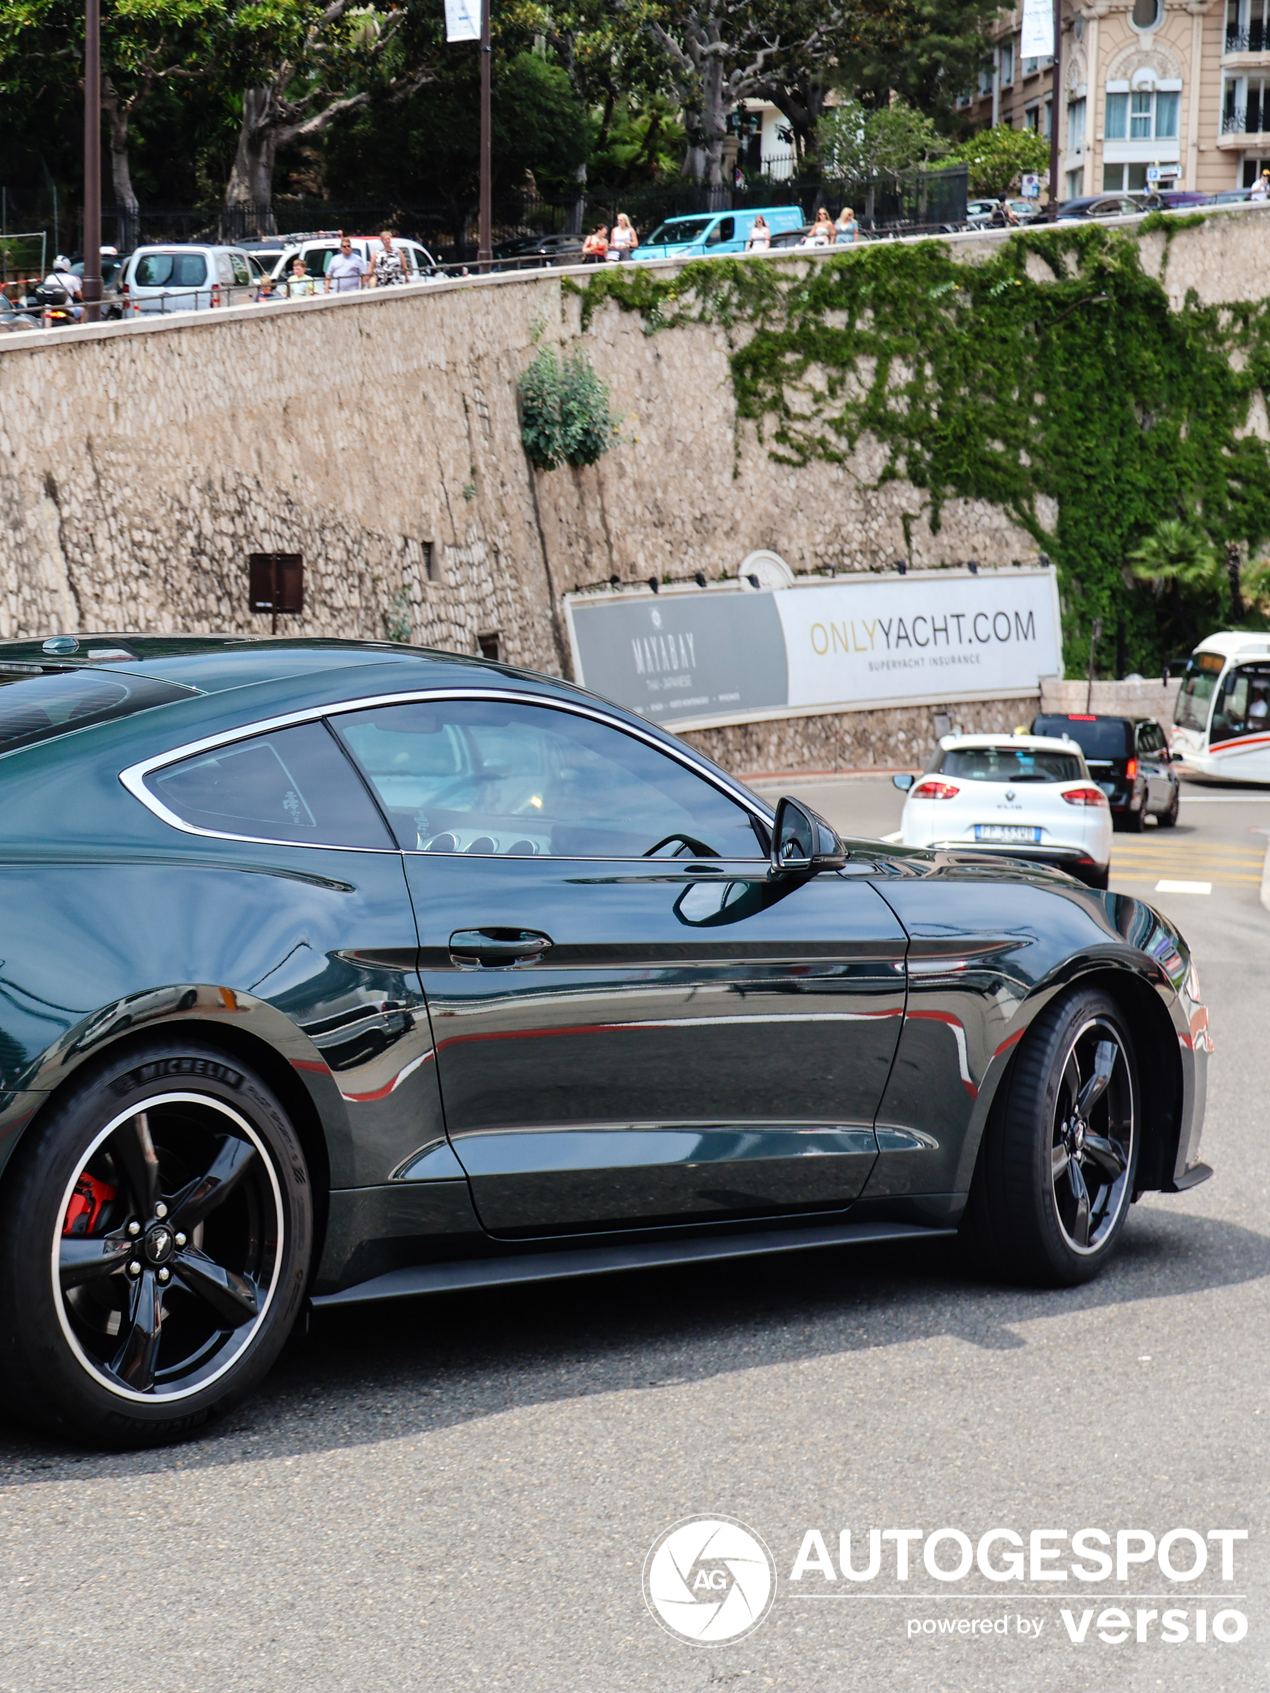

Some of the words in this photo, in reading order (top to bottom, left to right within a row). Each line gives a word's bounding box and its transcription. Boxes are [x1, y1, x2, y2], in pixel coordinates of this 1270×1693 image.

[811, 610, 1037, 655] ONLYYACHT.COM
[631, 632, 697, 675] MAYABAY
[868, 657, 925, 672] SUPERYACHT
[929, 653, 982, 667] INSURANCE
[139, 1059, 239, 1086] MICHELIN
